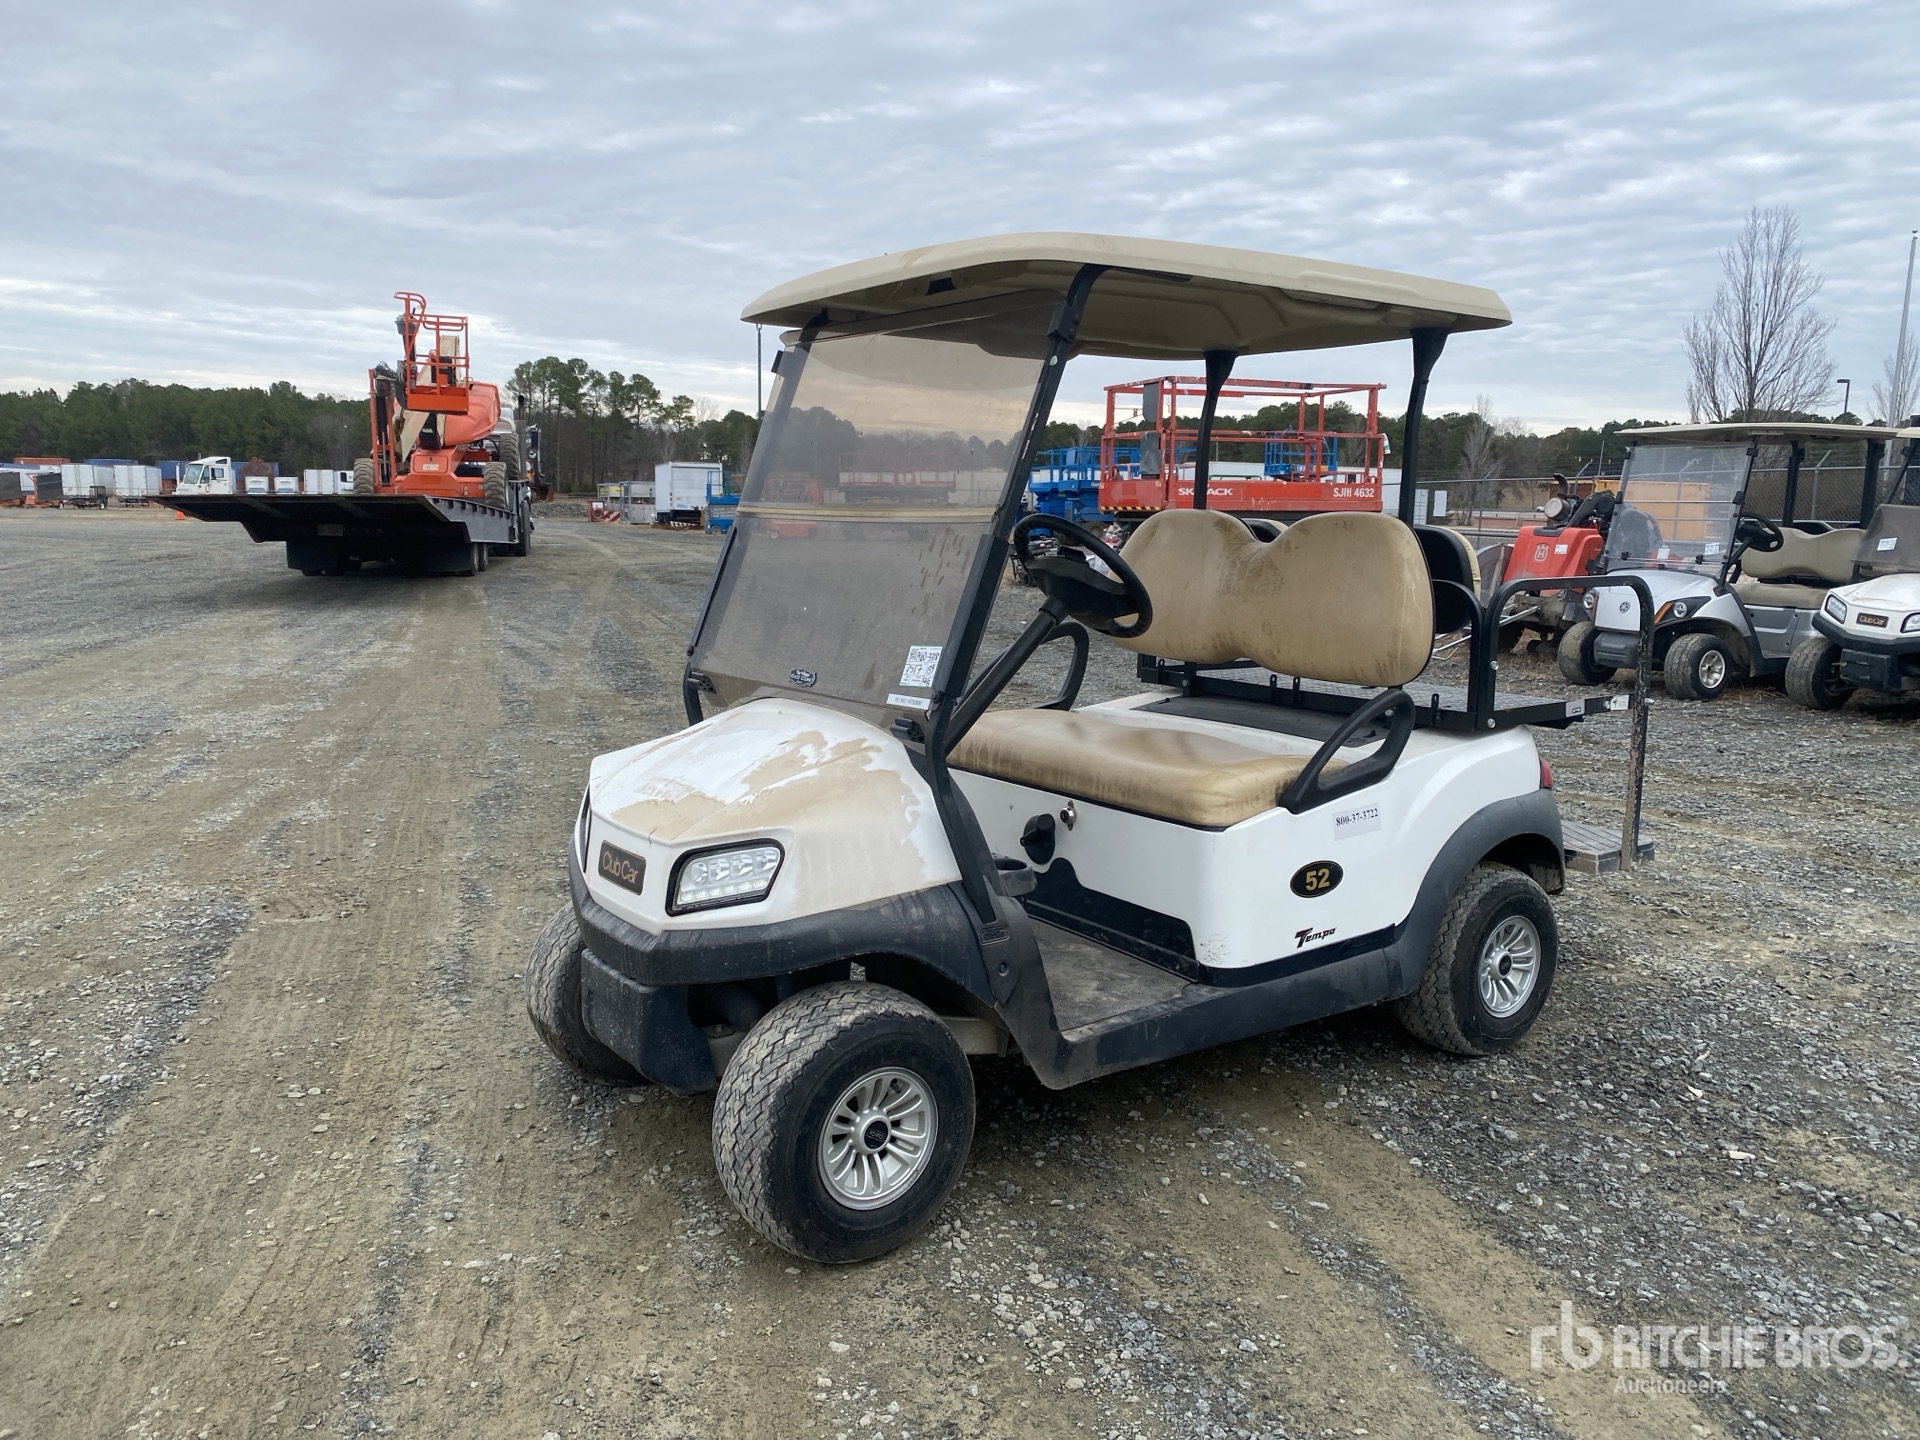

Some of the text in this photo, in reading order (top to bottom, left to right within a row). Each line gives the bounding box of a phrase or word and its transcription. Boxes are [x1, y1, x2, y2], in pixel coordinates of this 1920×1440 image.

[1178, 487, 1233, 496] SKACK
[1353, 487, 1375, 498] 4632
[1335, 808, 1379, 827] 800-37-3722
[602, 851, 639, 884] Club Car
[1305, 868, 1331, 891] 52
[1294, 927, 1337, 949] Tempo
